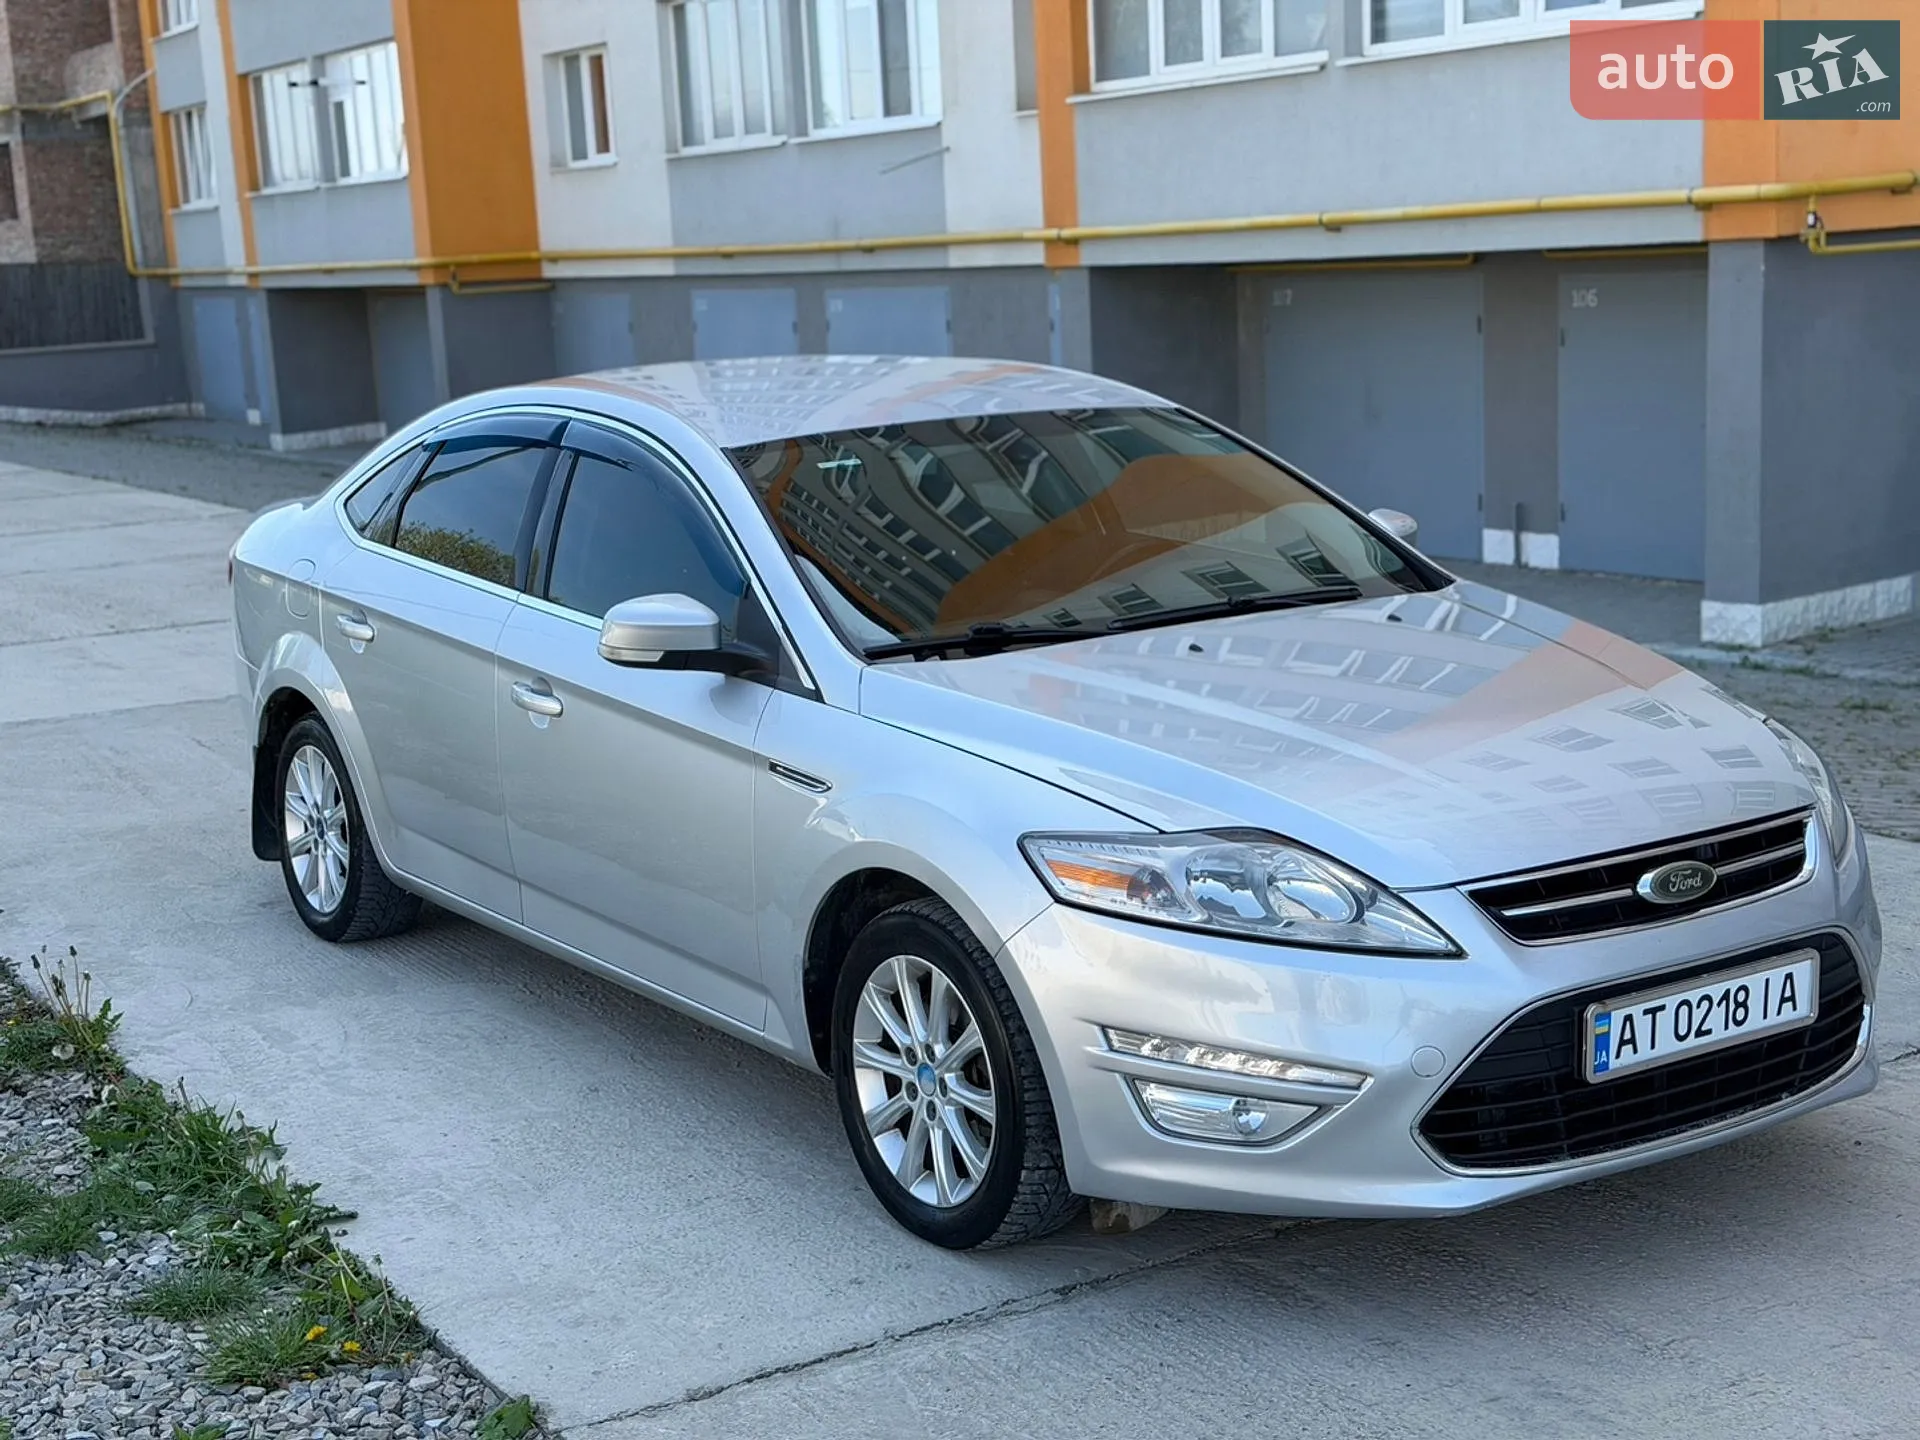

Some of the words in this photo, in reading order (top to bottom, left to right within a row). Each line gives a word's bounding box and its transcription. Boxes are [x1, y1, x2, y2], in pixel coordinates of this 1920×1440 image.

[1571, 288, 1598, 308] 106
[1669, 869, 1703, 892] Ford
[1615, 1004, 1667, 1060] AT
[1673, 984, 1750, 1042] 0218
